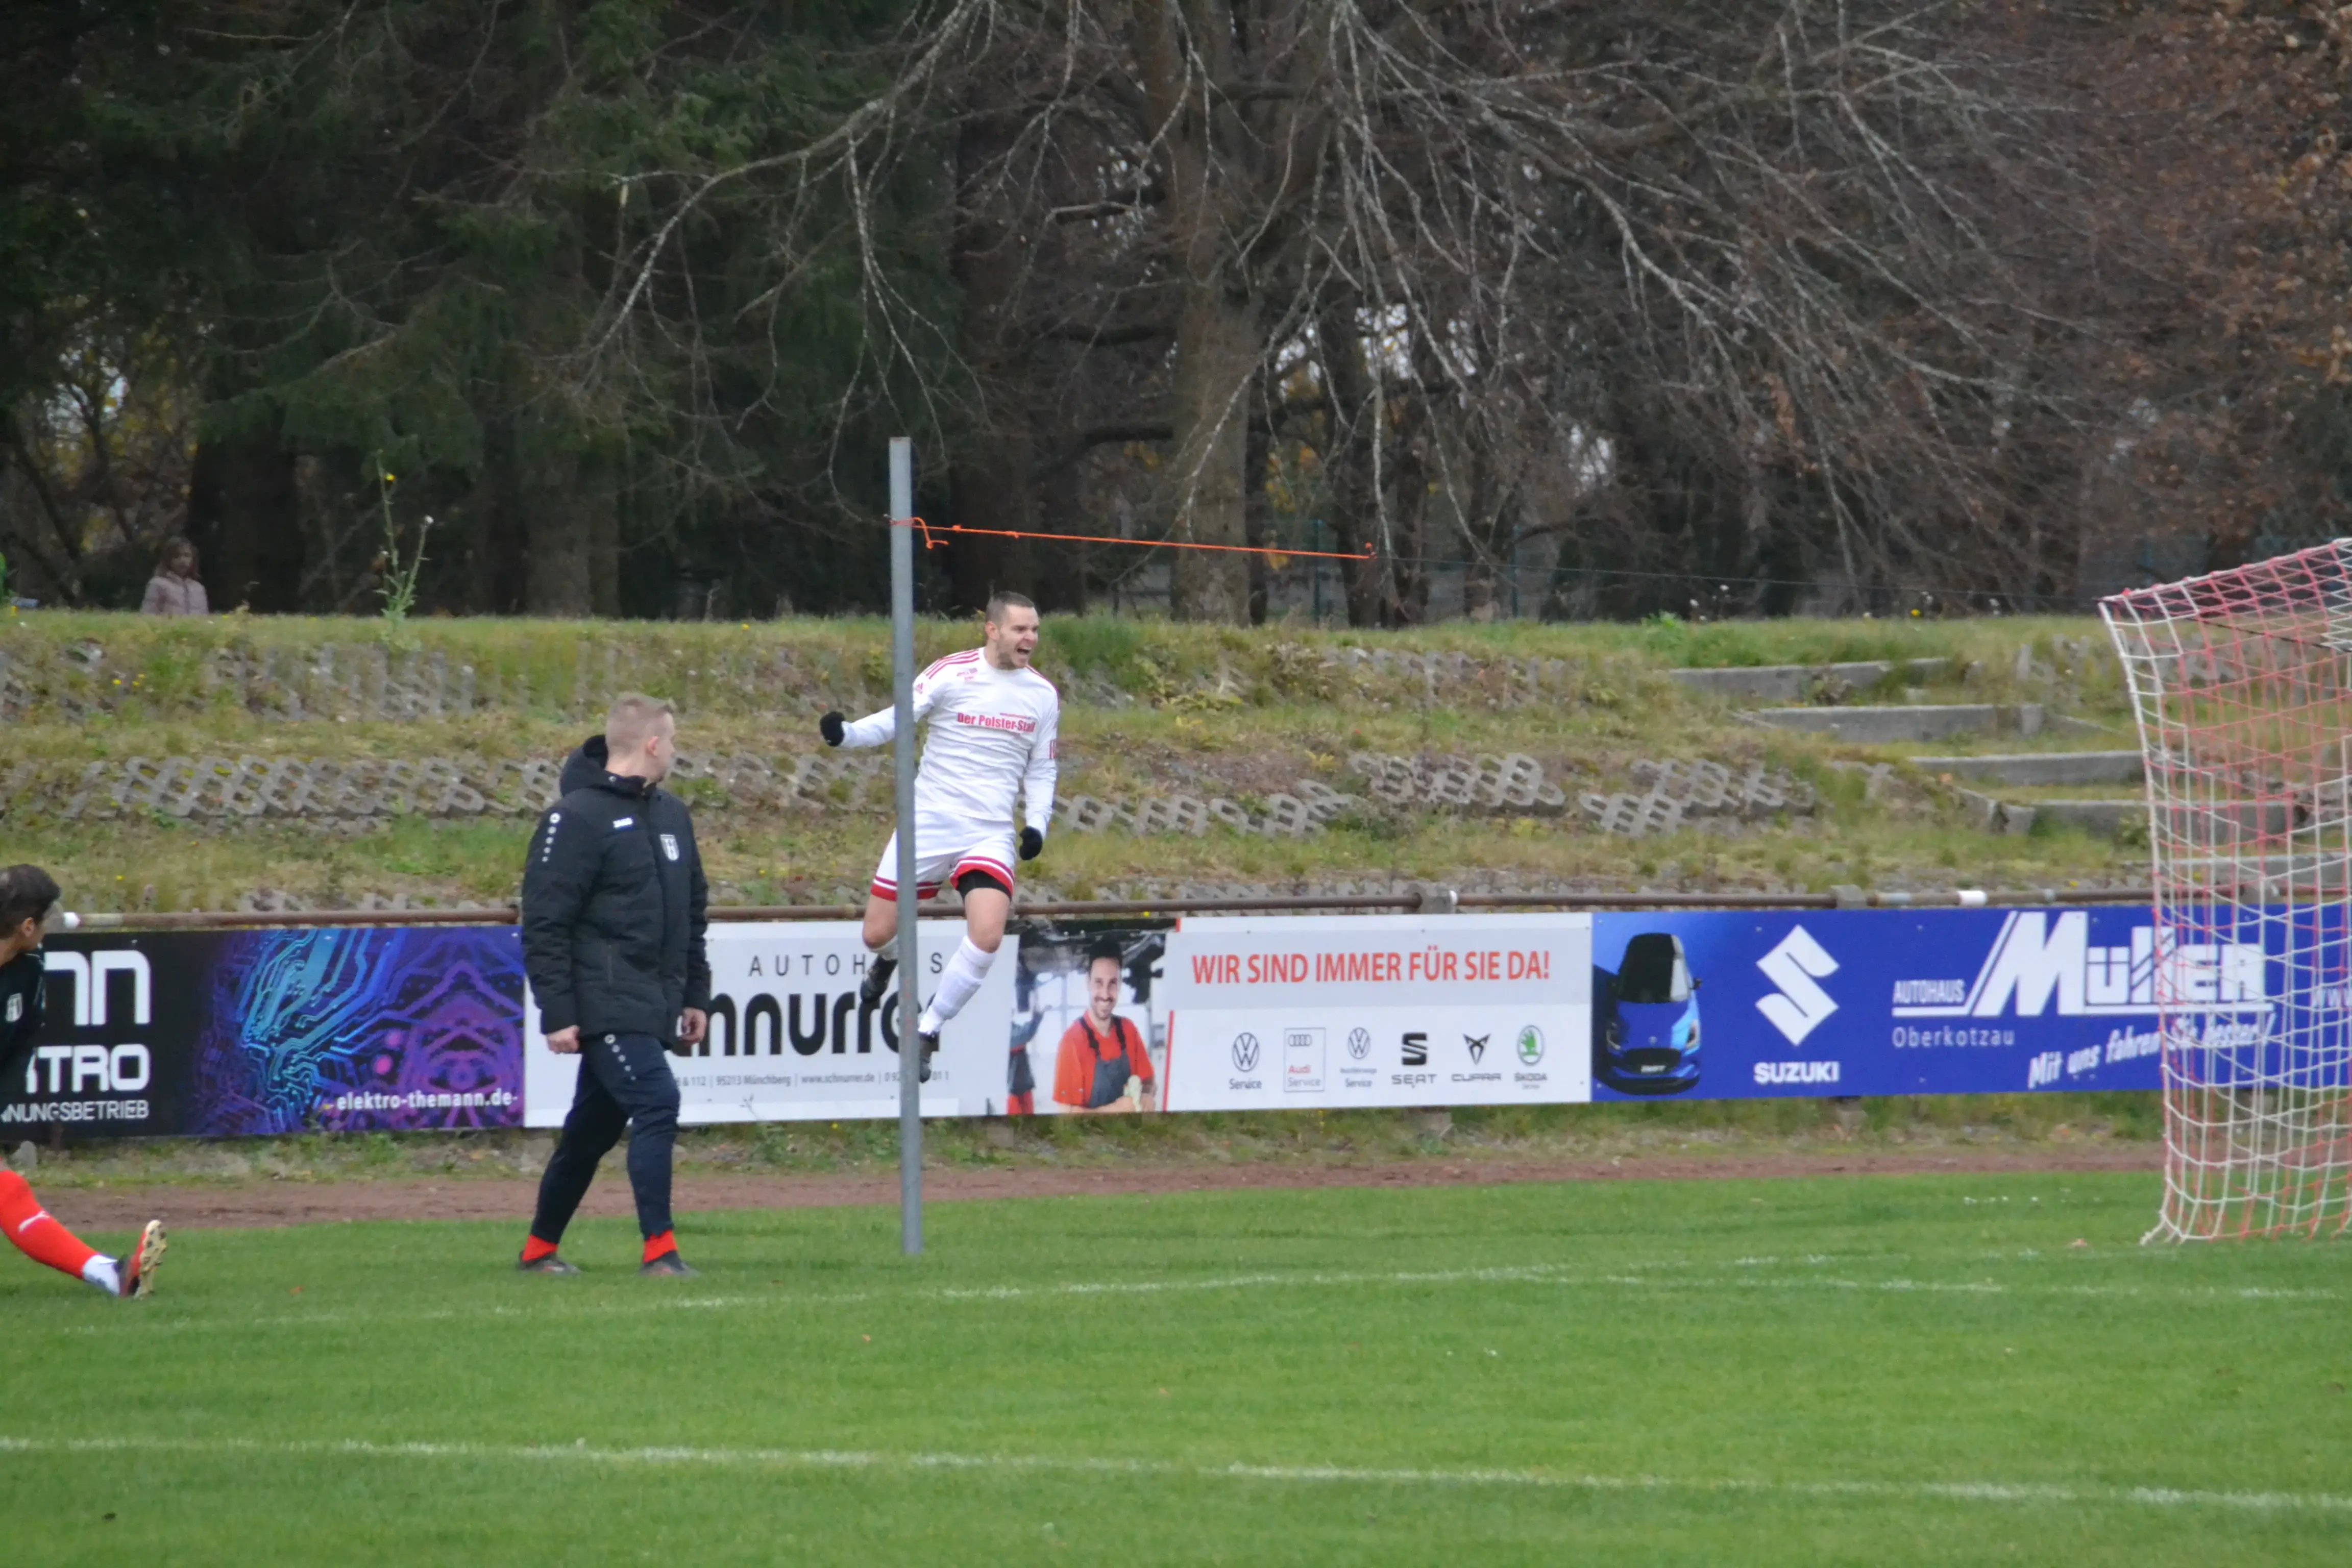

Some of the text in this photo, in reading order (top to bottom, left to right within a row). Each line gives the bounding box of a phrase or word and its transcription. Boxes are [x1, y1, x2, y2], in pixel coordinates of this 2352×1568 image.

[958, 713, 976, 725] Der
[748, 952, 943, 976] AUTOHS
[1192, 945, 1550, 984] WIR SIND IMMER FÜR SIE DA!
[1893, 979, 1965, 1003] AUTOHAUS
[1892, 1025, 2016, 1048] Oberkotzau
[1288, 1065, 1311, 1074] Audi
[2027, 1051, 2064, 1090] Mit
[2066, 1043, 2102, 1075] uns
[1451, 1073, 1502, 1082] CUPRA
[1754, 1061, 1840, 1085] SUZUKI
[1229, 1078, 1262, 1090] Service
[1288, 1076, 1321, 1087] Service
[1344, 1077, 1373, 1088] Service
[1391, 1074, 1437, 1085] SEAT
